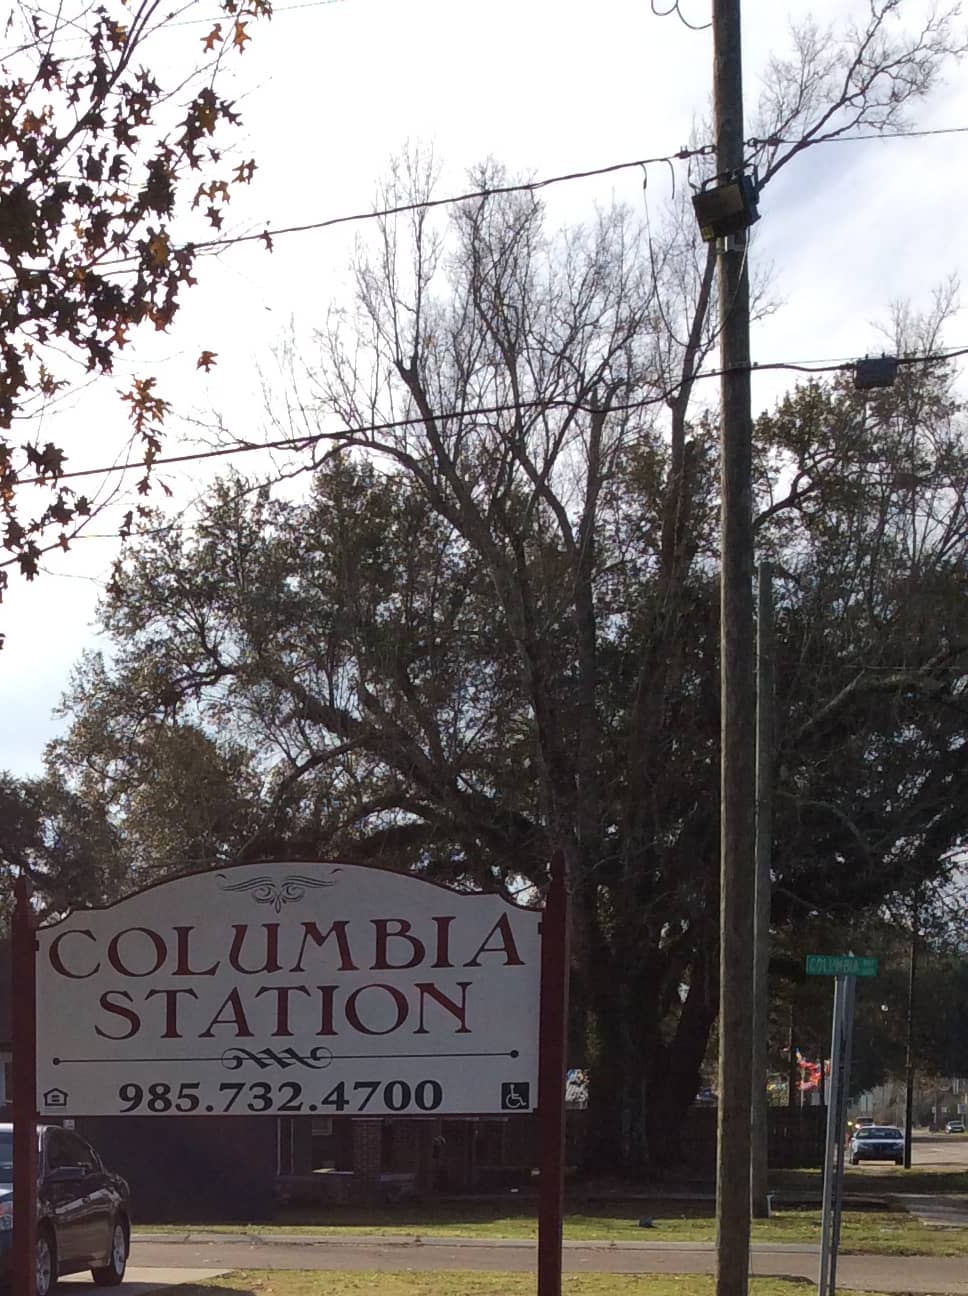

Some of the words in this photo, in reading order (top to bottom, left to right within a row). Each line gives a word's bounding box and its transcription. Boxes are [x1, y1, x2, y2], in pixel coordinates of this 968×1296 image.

[48, 912, 525, 978] COLUMBIA
[94, 982, 473, 1040] STATION
[118, 1080, 444, 1113] 985.732.4700
